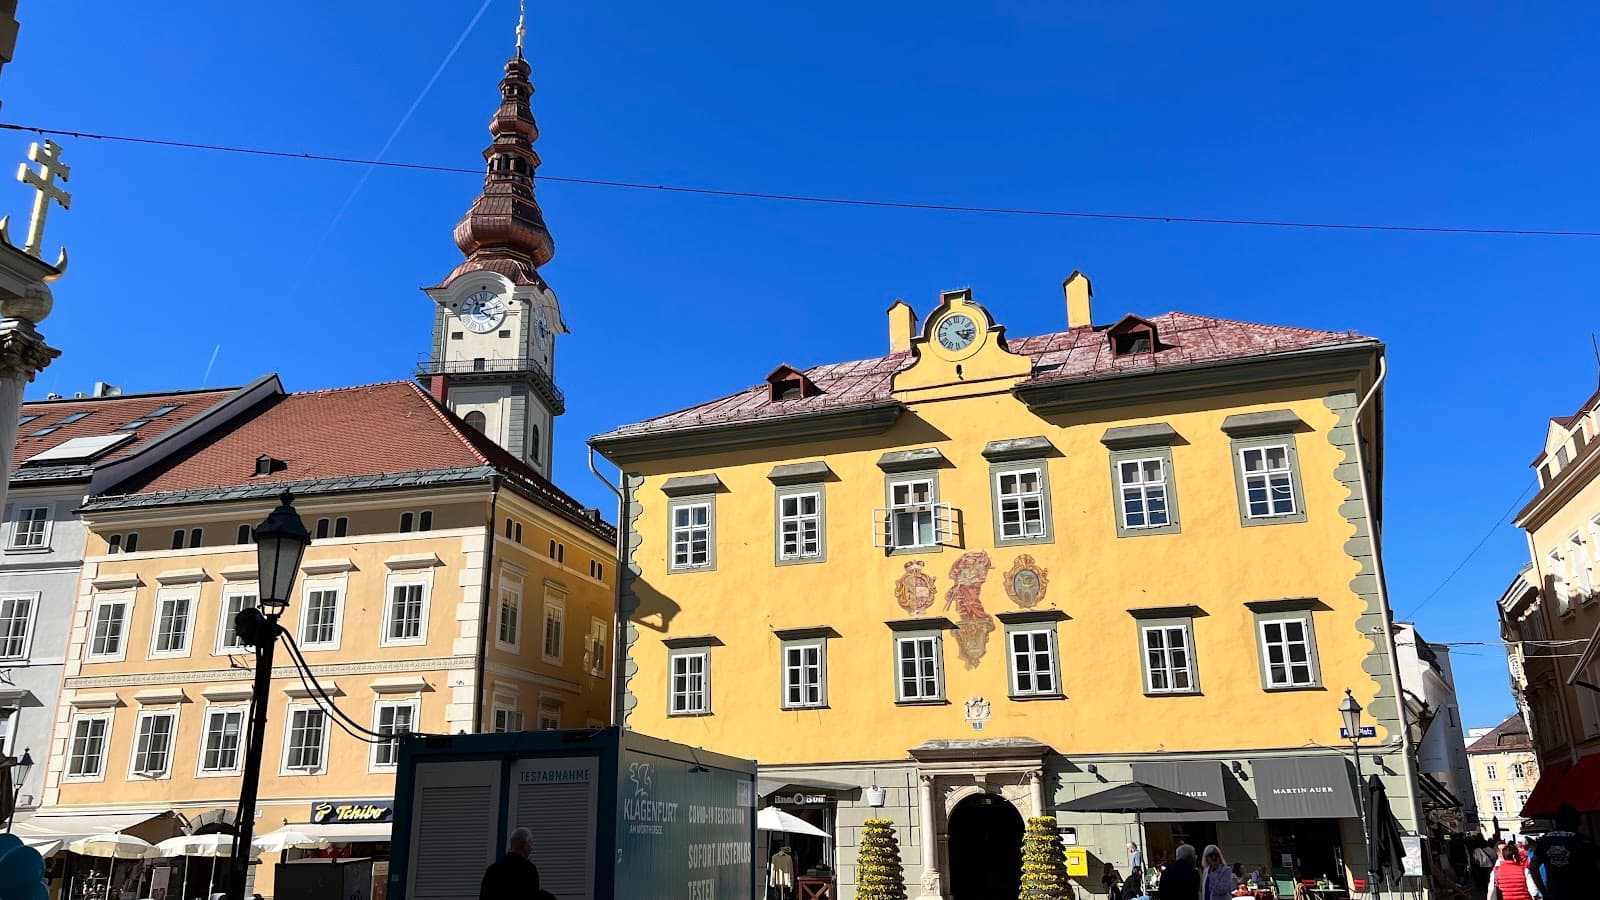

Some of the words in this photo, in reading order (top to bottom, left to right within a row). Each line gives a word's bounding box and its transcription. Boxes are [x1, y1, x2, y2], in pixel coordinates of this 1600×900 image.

[520, 768, 591, 782] TESTABNAHME
[1273, 787, 1307, 795] MARTIN
[1309, 786, 1334, 794] AUER
[336, 804, 387, 820] Tchibo
[623, 798, 679, 823] KLAGENFURT
[688, 805, 714, 824] COVID-19
[688, 843, 716, 869] SOFORT
[717, 841, 752, 866] KOSTENLOS
[687, 879, 716, 900] TESTEN
